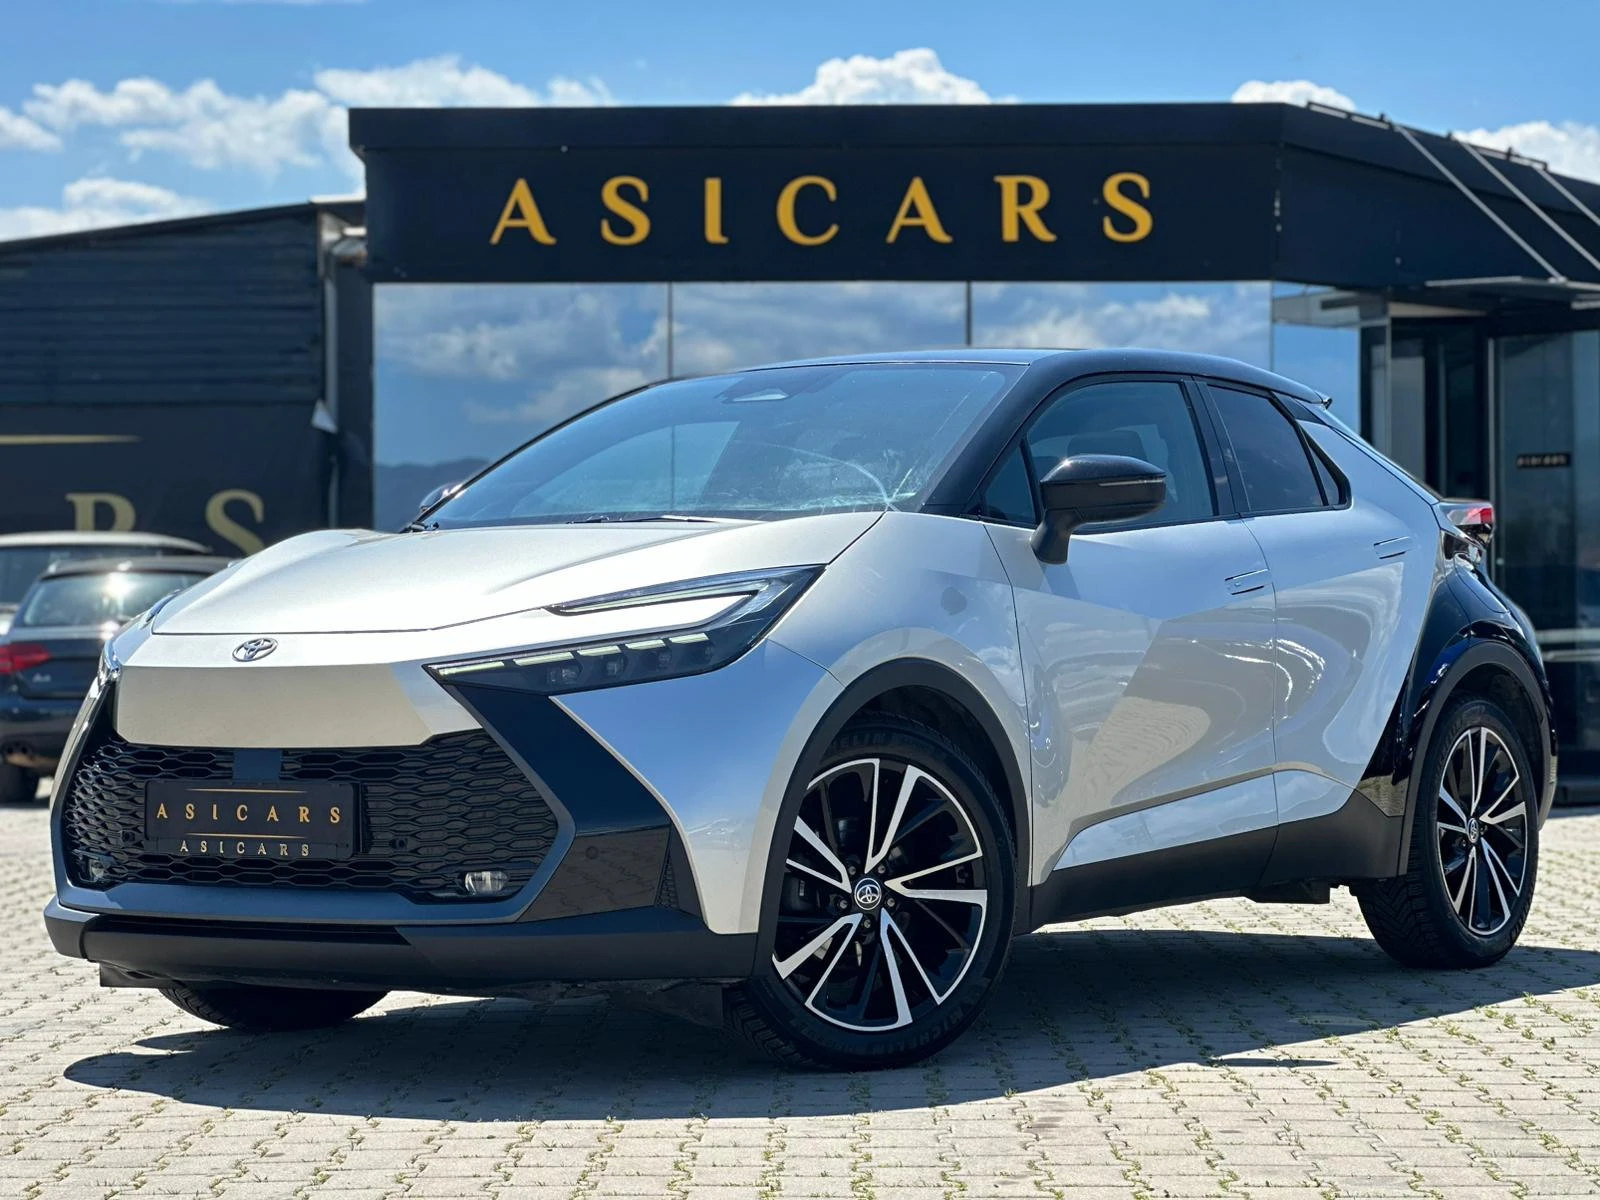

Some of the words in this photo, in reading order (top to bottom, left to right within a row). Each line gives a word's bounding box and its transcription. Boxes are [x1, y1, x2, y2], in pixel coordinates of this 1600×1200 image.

[491, 173, 1153, 246] ASICARS
[156, 803, 341, 824] ASICARS
[180, 840, 309, 857] ASICARS
